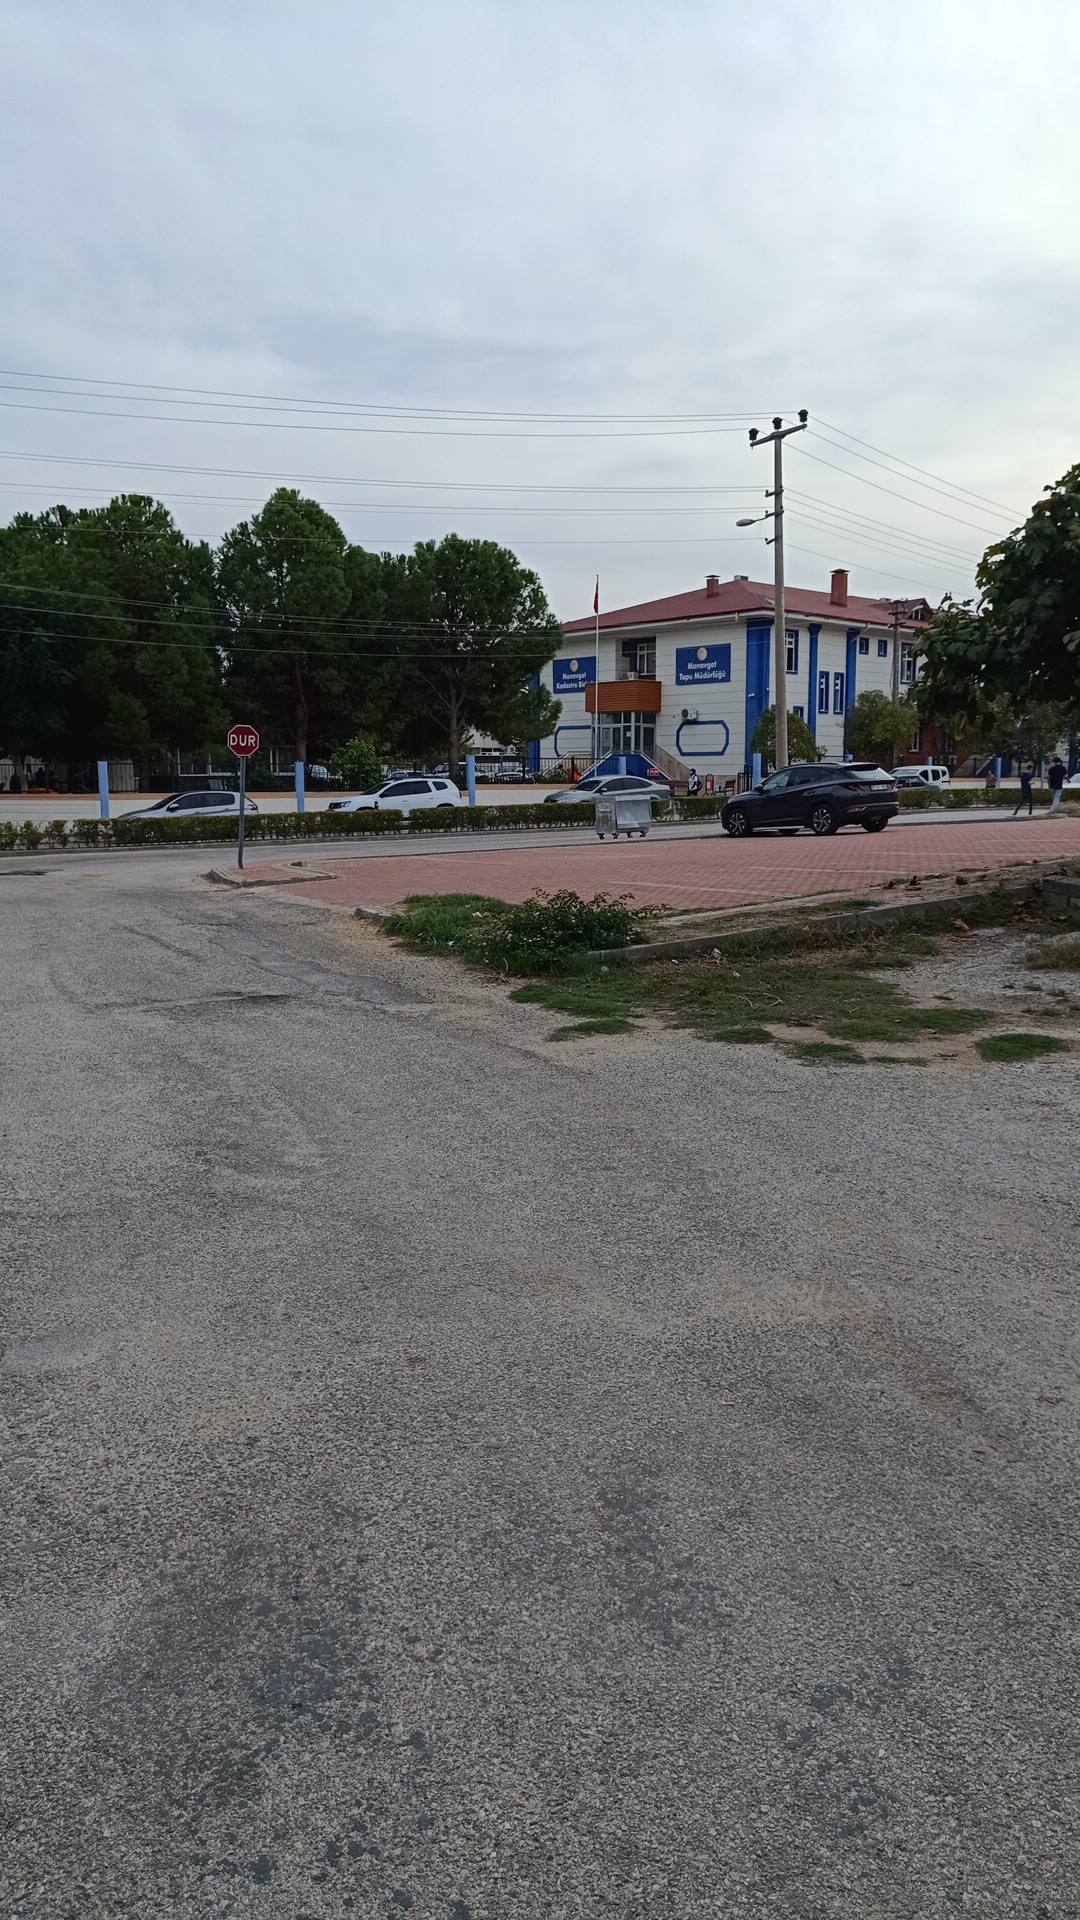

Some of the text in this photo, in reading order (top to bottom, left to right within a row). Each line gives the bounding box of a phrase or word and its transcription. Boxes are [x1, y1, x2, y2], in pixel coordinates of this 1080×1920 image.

[687, 661, 717, 670] Manavgat
[562, 672, 587, 680] Manavgat
[679, 670, 726, 682] Tapu Müdürlüğü
[230, 734, 255, 746] DUR
